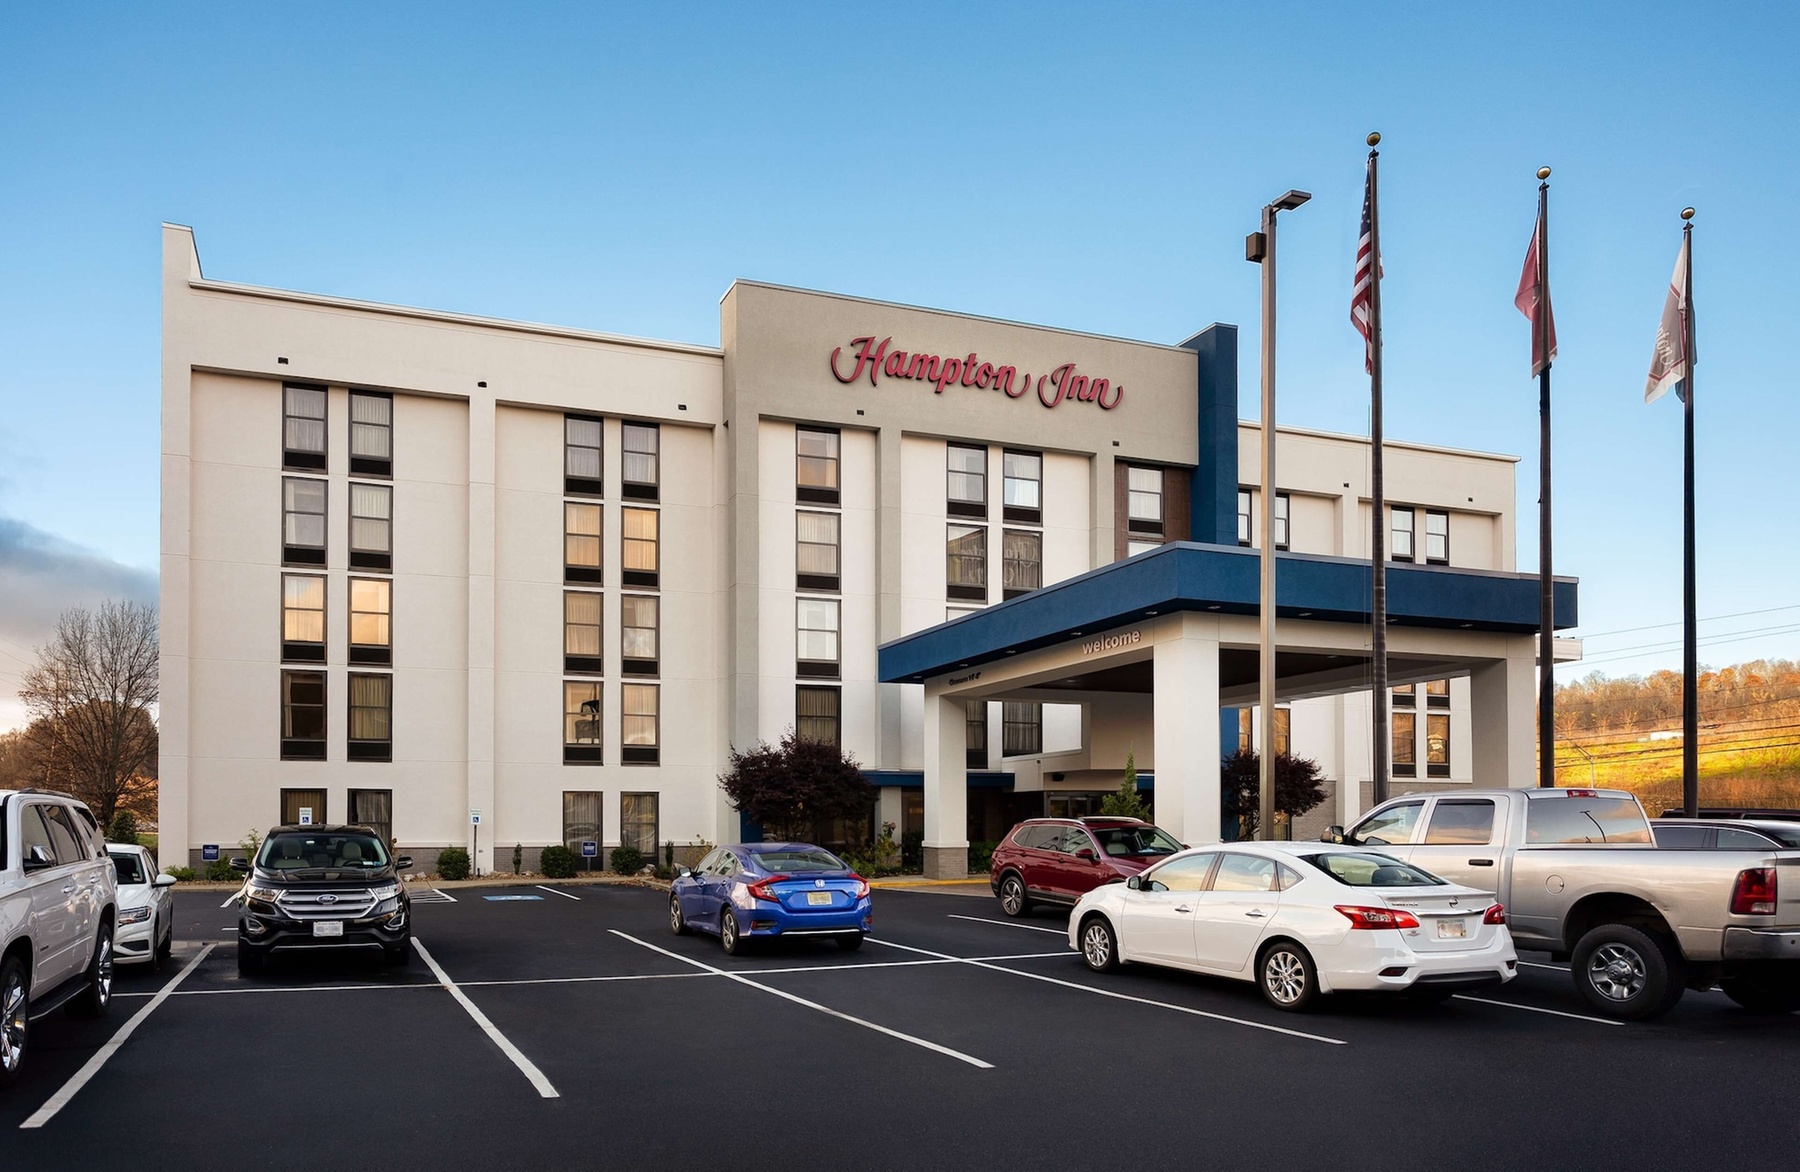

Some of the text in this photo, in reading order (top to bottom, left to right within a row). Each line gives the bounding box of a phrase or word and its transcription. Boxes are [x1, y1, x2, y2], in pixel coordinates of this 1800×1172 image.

[831, 336, 1123, 409] Hampton Inn
[1082, 630, 1141, 655] welcome
